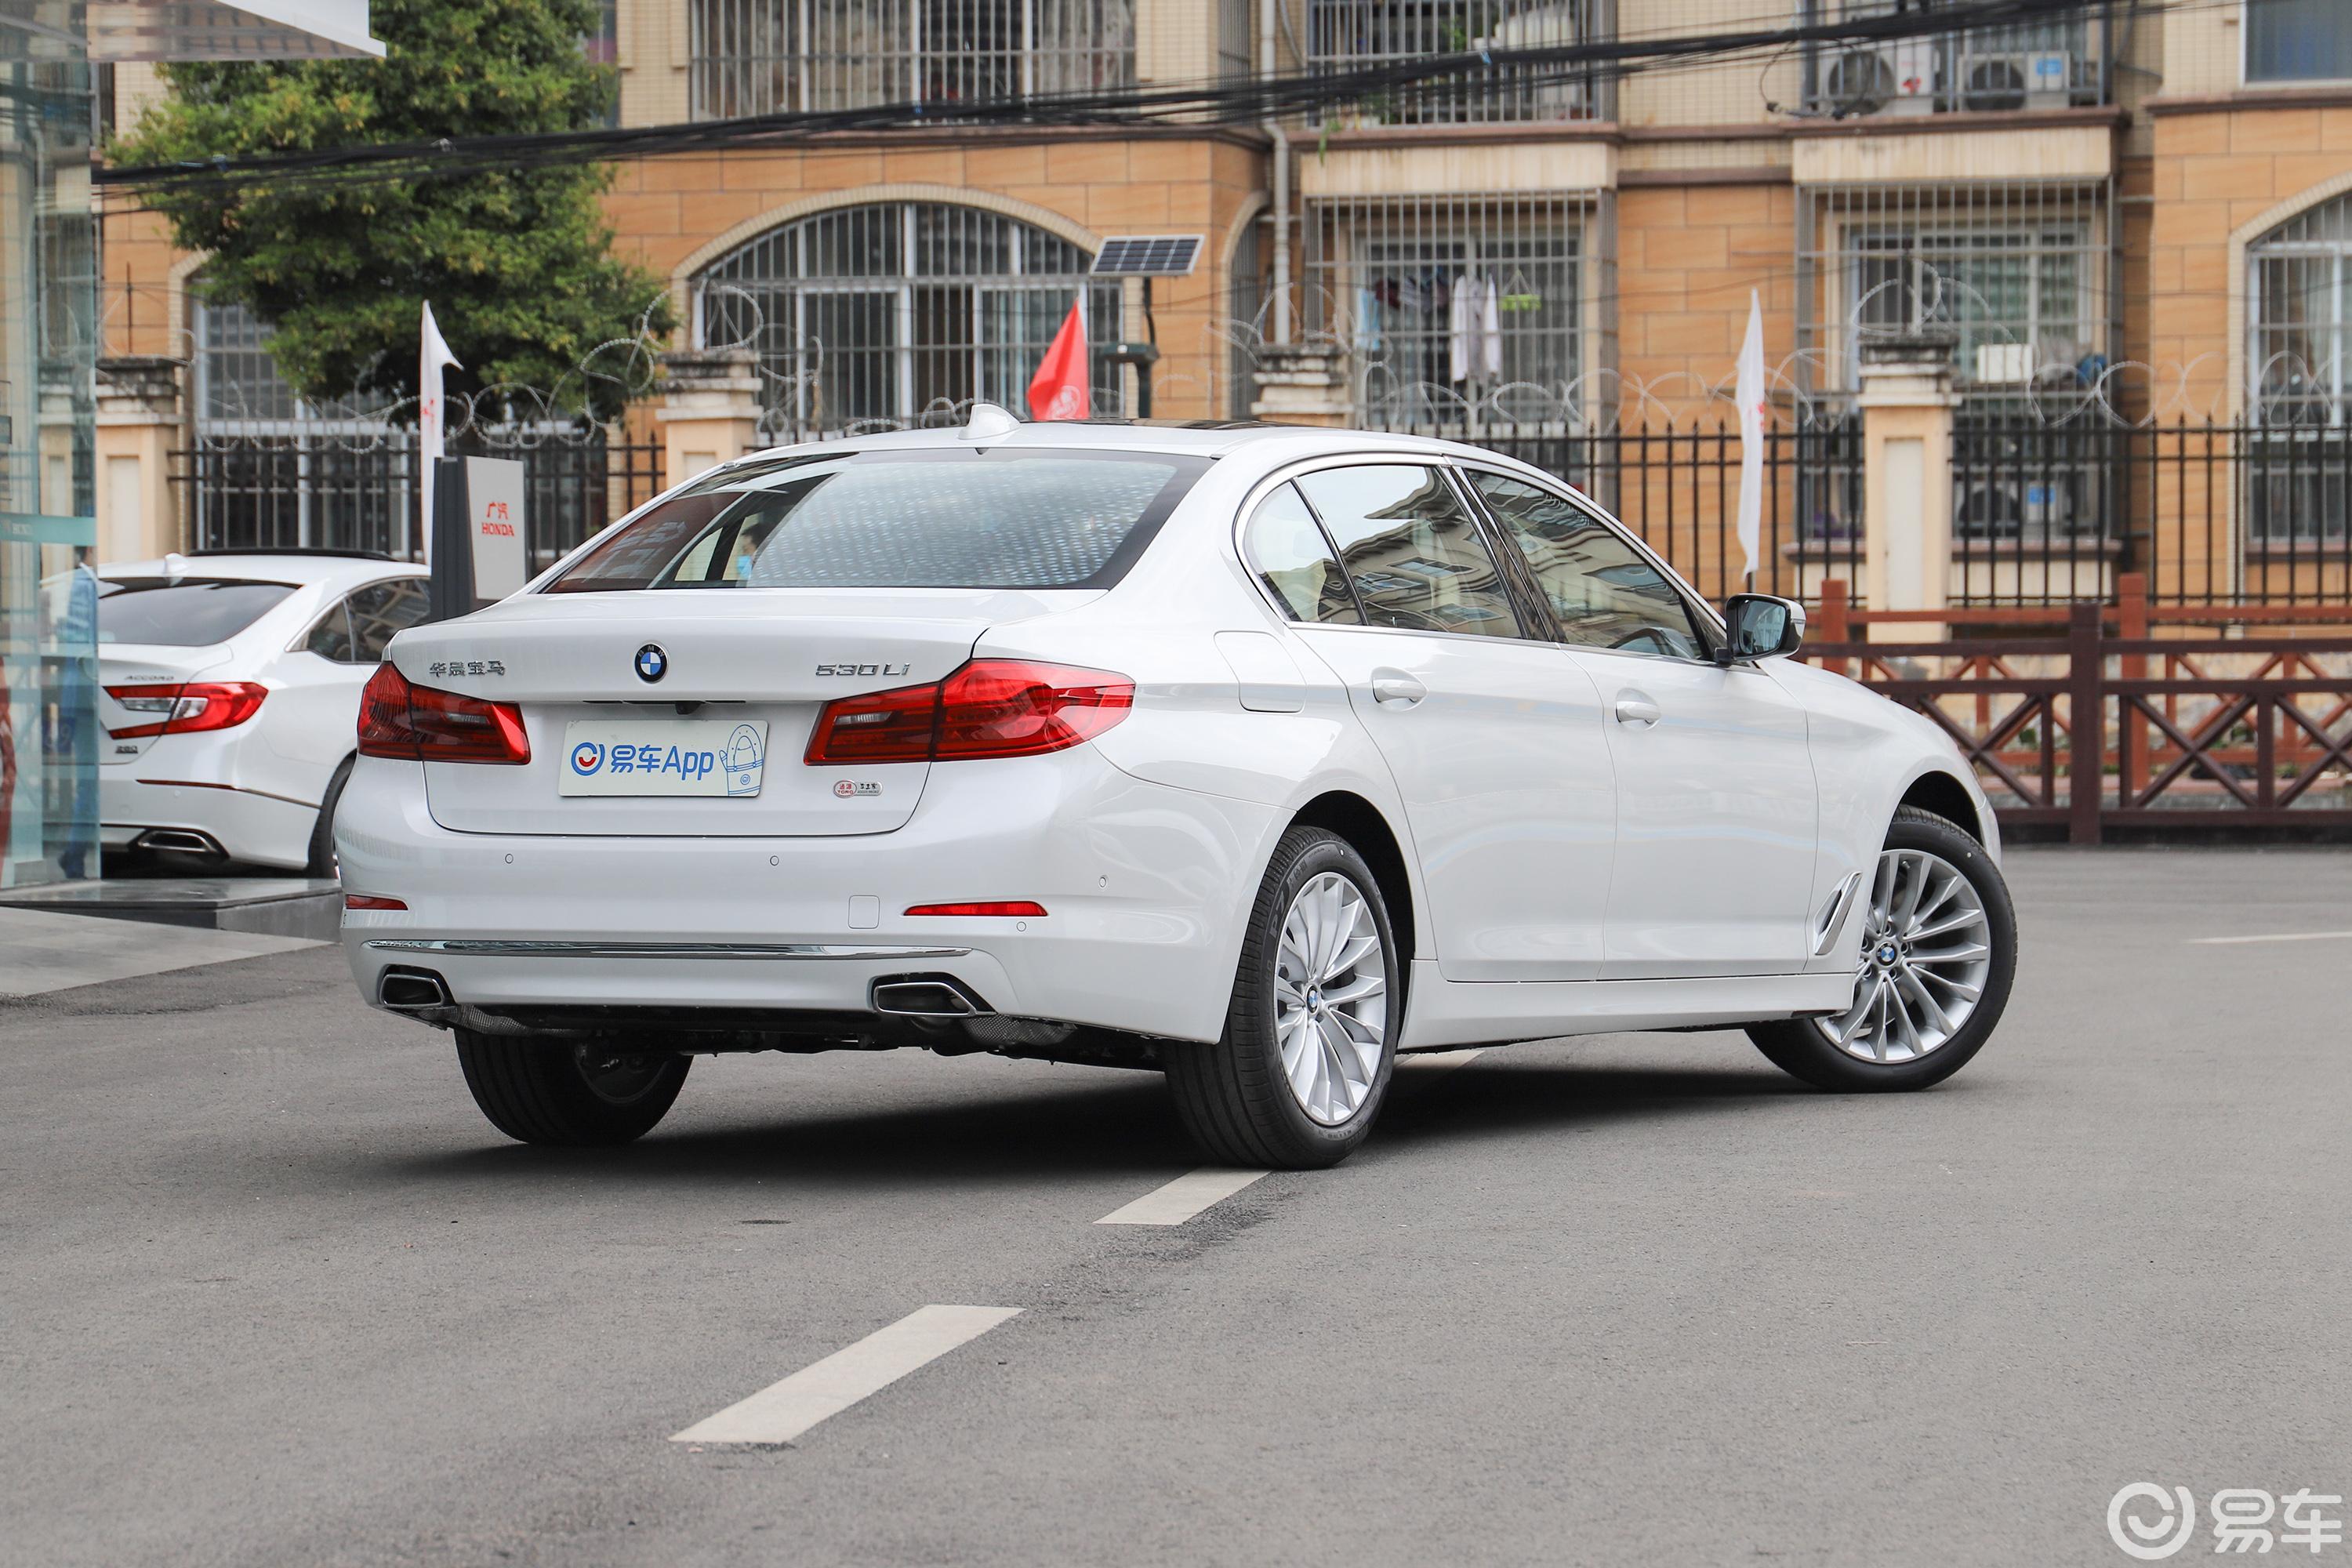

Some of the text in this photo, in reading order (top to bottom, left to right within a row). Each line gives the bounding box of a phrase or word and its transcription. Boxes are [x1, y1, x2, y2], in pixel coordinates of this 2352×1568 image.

[481, 522, 515, 536] HONDA
[429, 660, 506, 677] 华晨宝马
